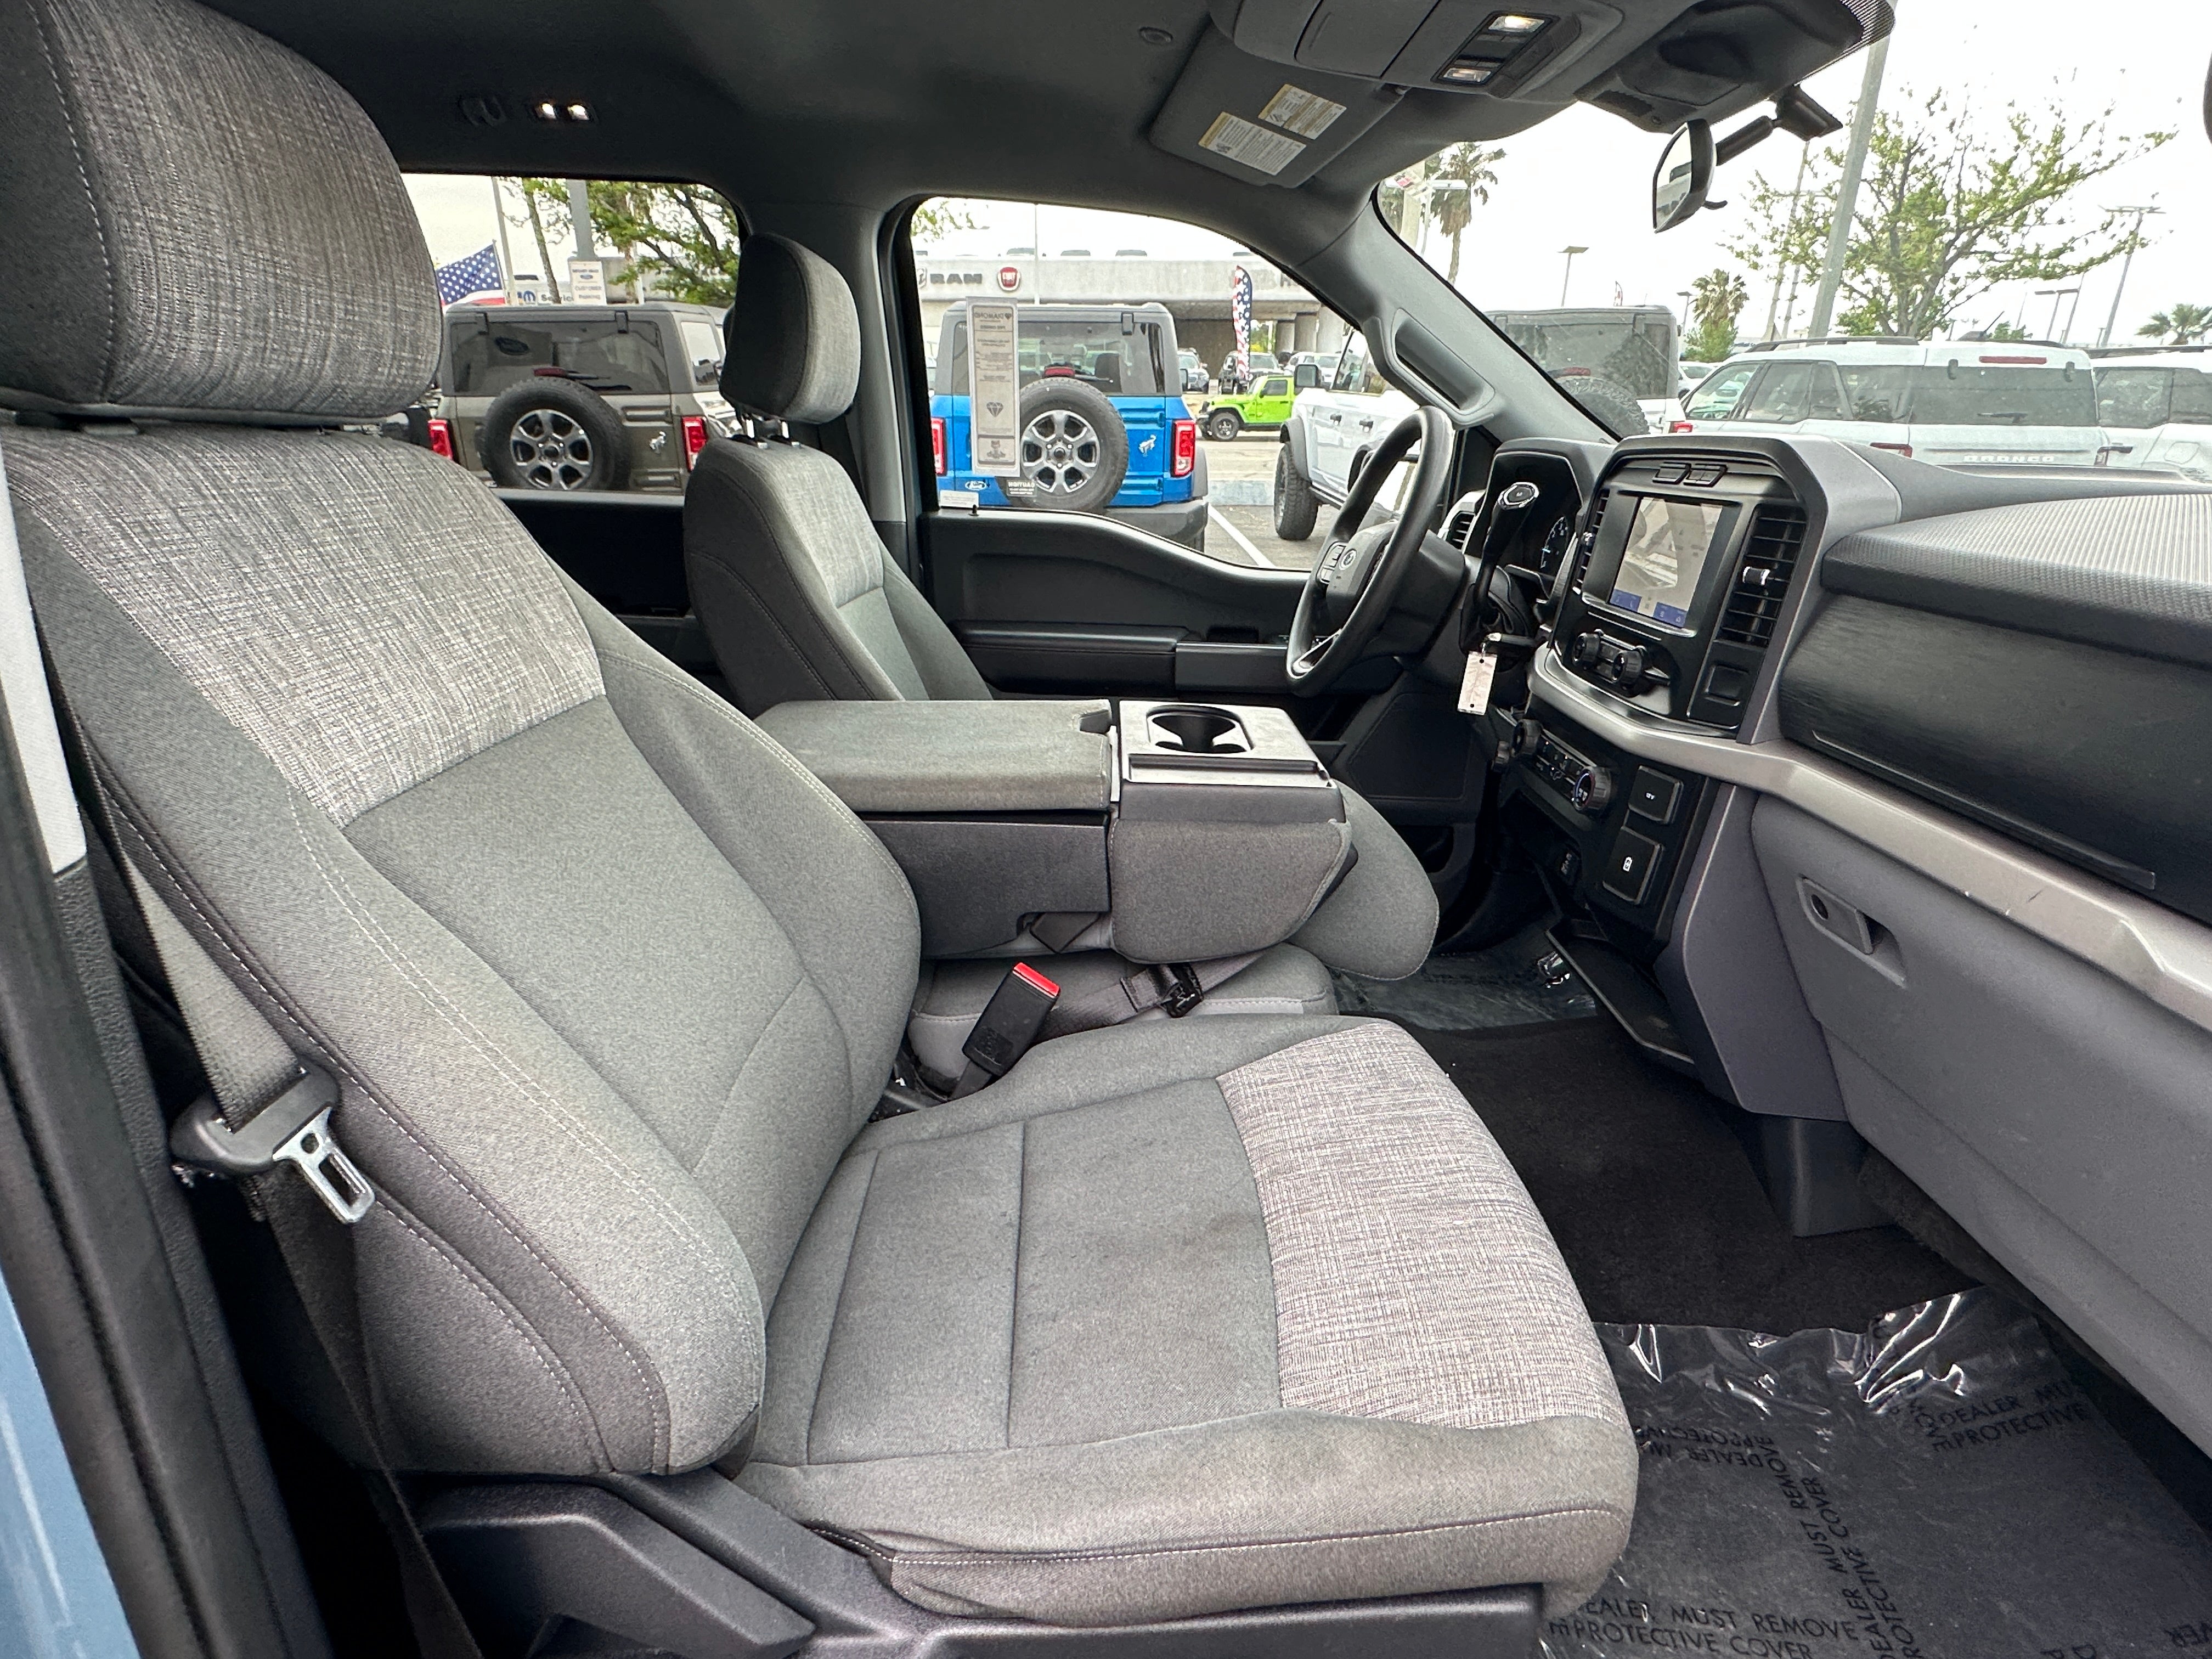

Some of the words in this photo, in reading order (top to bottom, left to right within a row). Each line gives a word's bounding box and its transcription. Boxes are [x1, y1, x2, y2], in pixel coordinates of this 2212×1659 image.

[929, 273, 982, 284] RAM
[1939, 1395, 2024, 1425] DEALER
[1952, 1401, 2089, 1449] PROTECTIVE
[1685, 1447, 1763, 1468] DEALER
[1756, 1435, 1809, 1510] REMOVE
[1801, 1477, 1850, 1537] COVER
[1799, 1520, 1848, 1574] MUST
[1578, 1598, 1655, 1622] EALER
[1672, 1605, 1738, 1629] MUST
[1751, 1613, 1859, 1641] REMOVE
[1839, 1546, 1921, 1659] ROTECTIVE
[1573, 1618, 1720, 1652] PROTECTIVE
[1729, 1635, 1812, 1659] COVER
